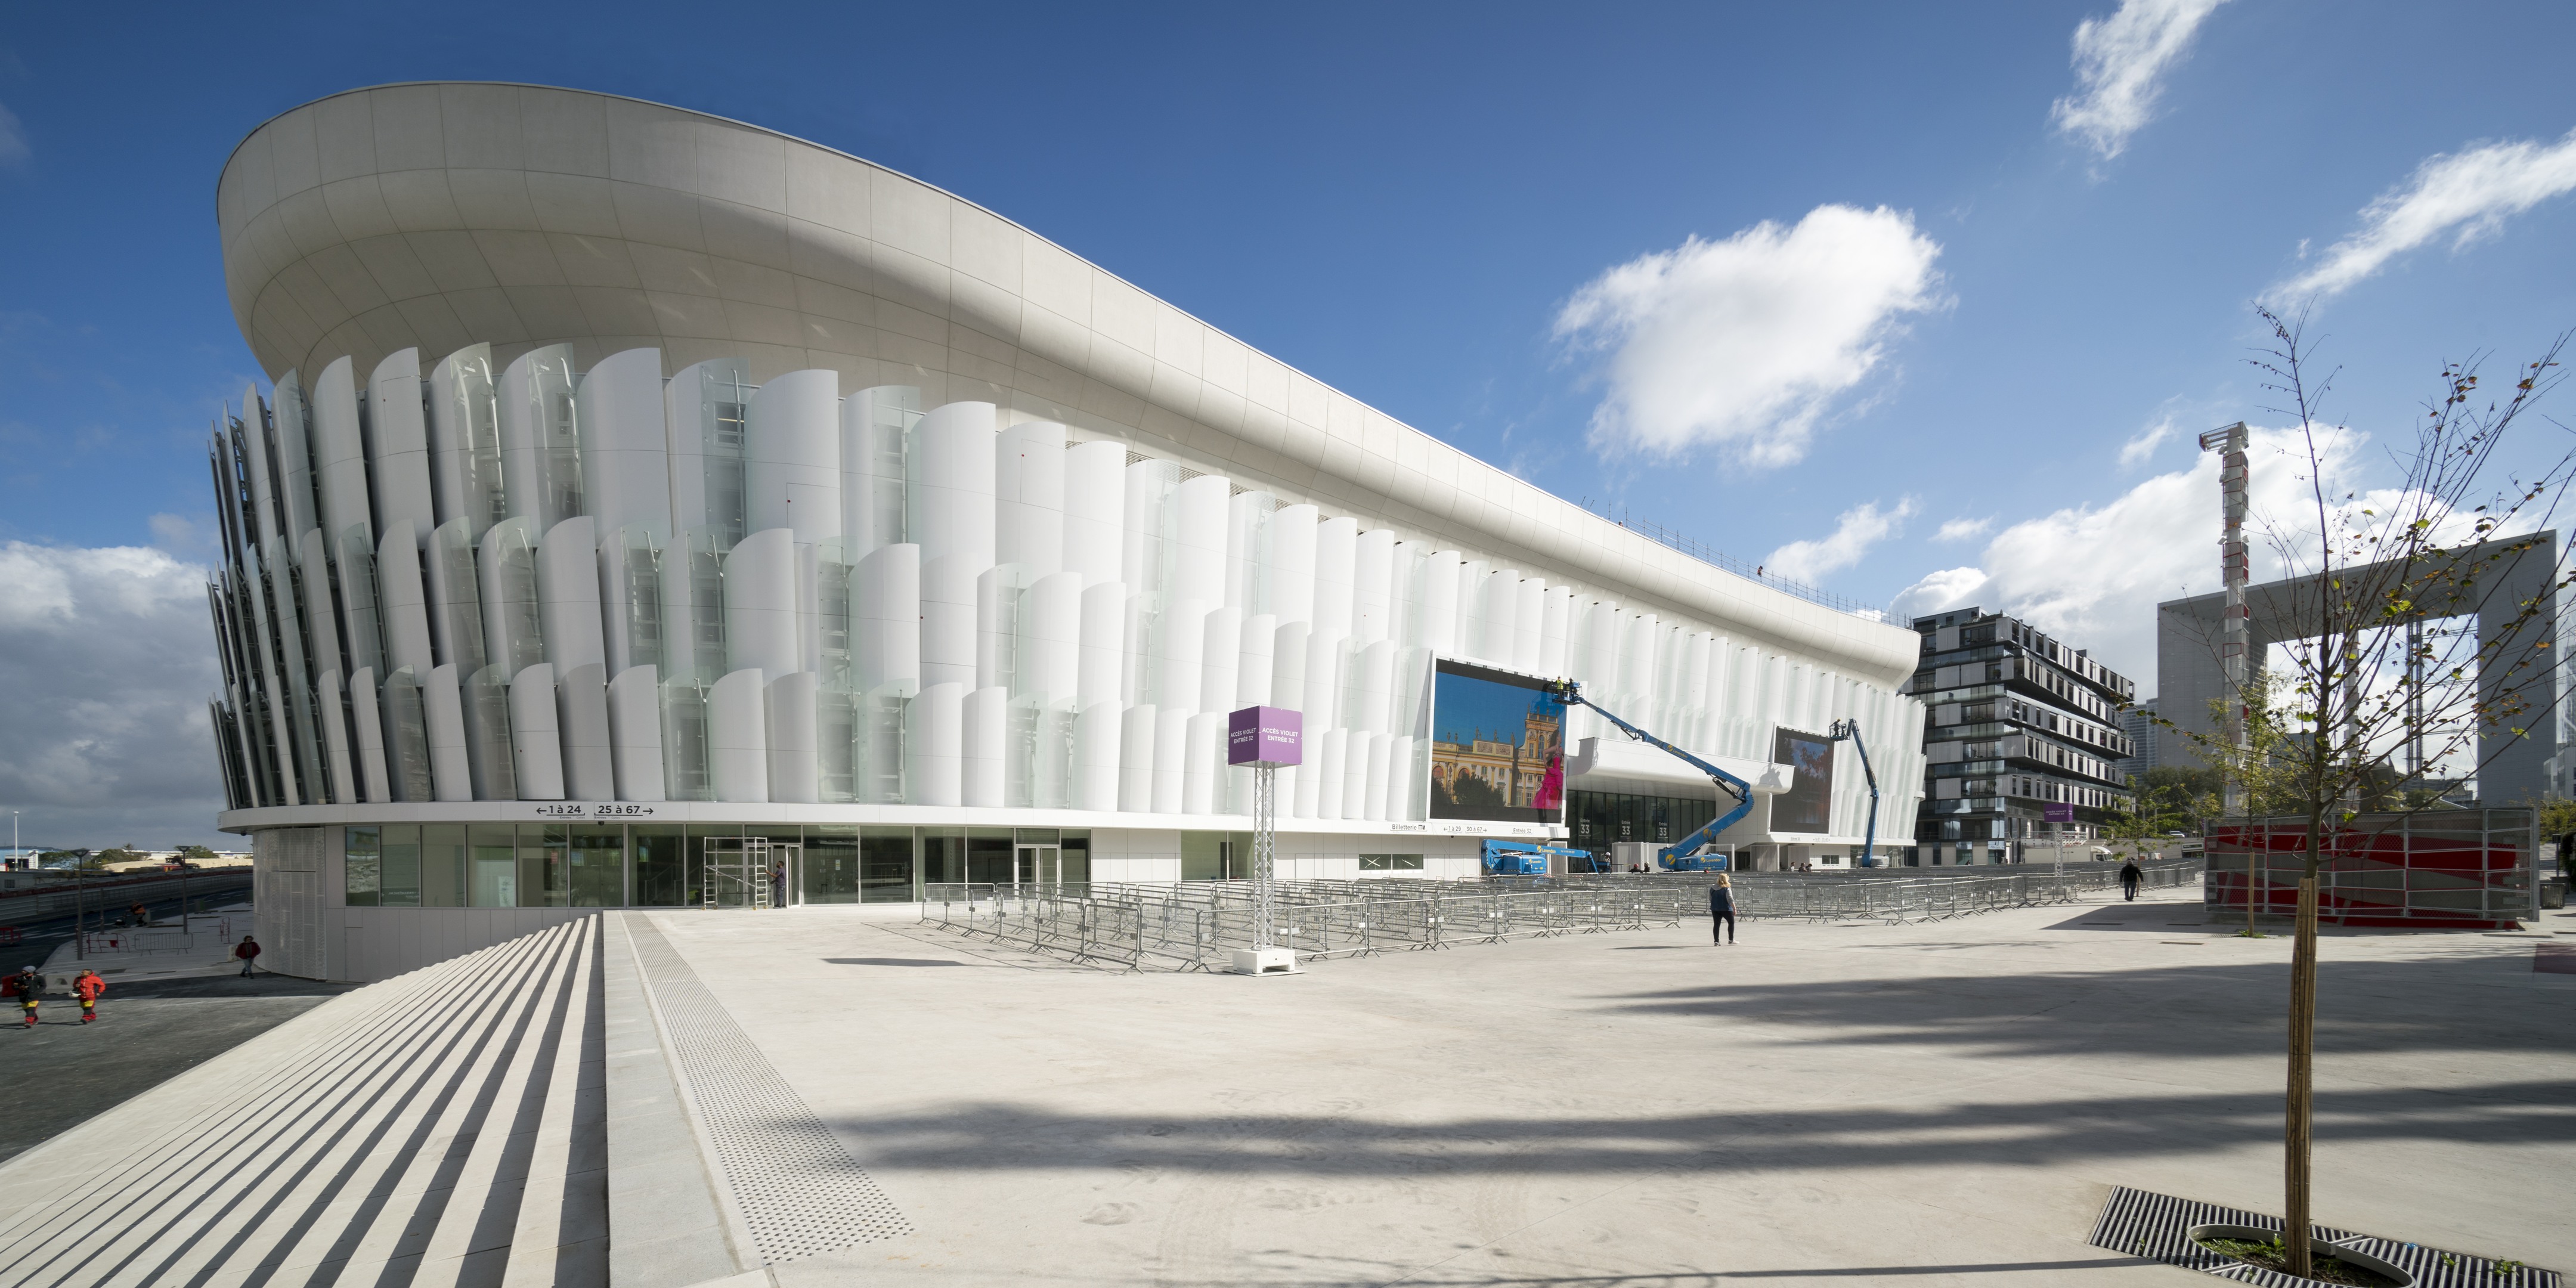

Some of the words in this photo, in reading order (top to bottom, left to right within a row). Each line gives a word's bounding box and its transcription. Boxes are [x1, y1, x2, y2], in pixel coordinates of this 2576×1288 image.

[557, 805, 564, 813] à
[615, 805, 622, 813] à
[626, 806, 640, 814] 67
[1581, 825, 1590, 834] 33
[1622, 826, 1630, 835] 33
[1659, 827, 1667, 836] 33
